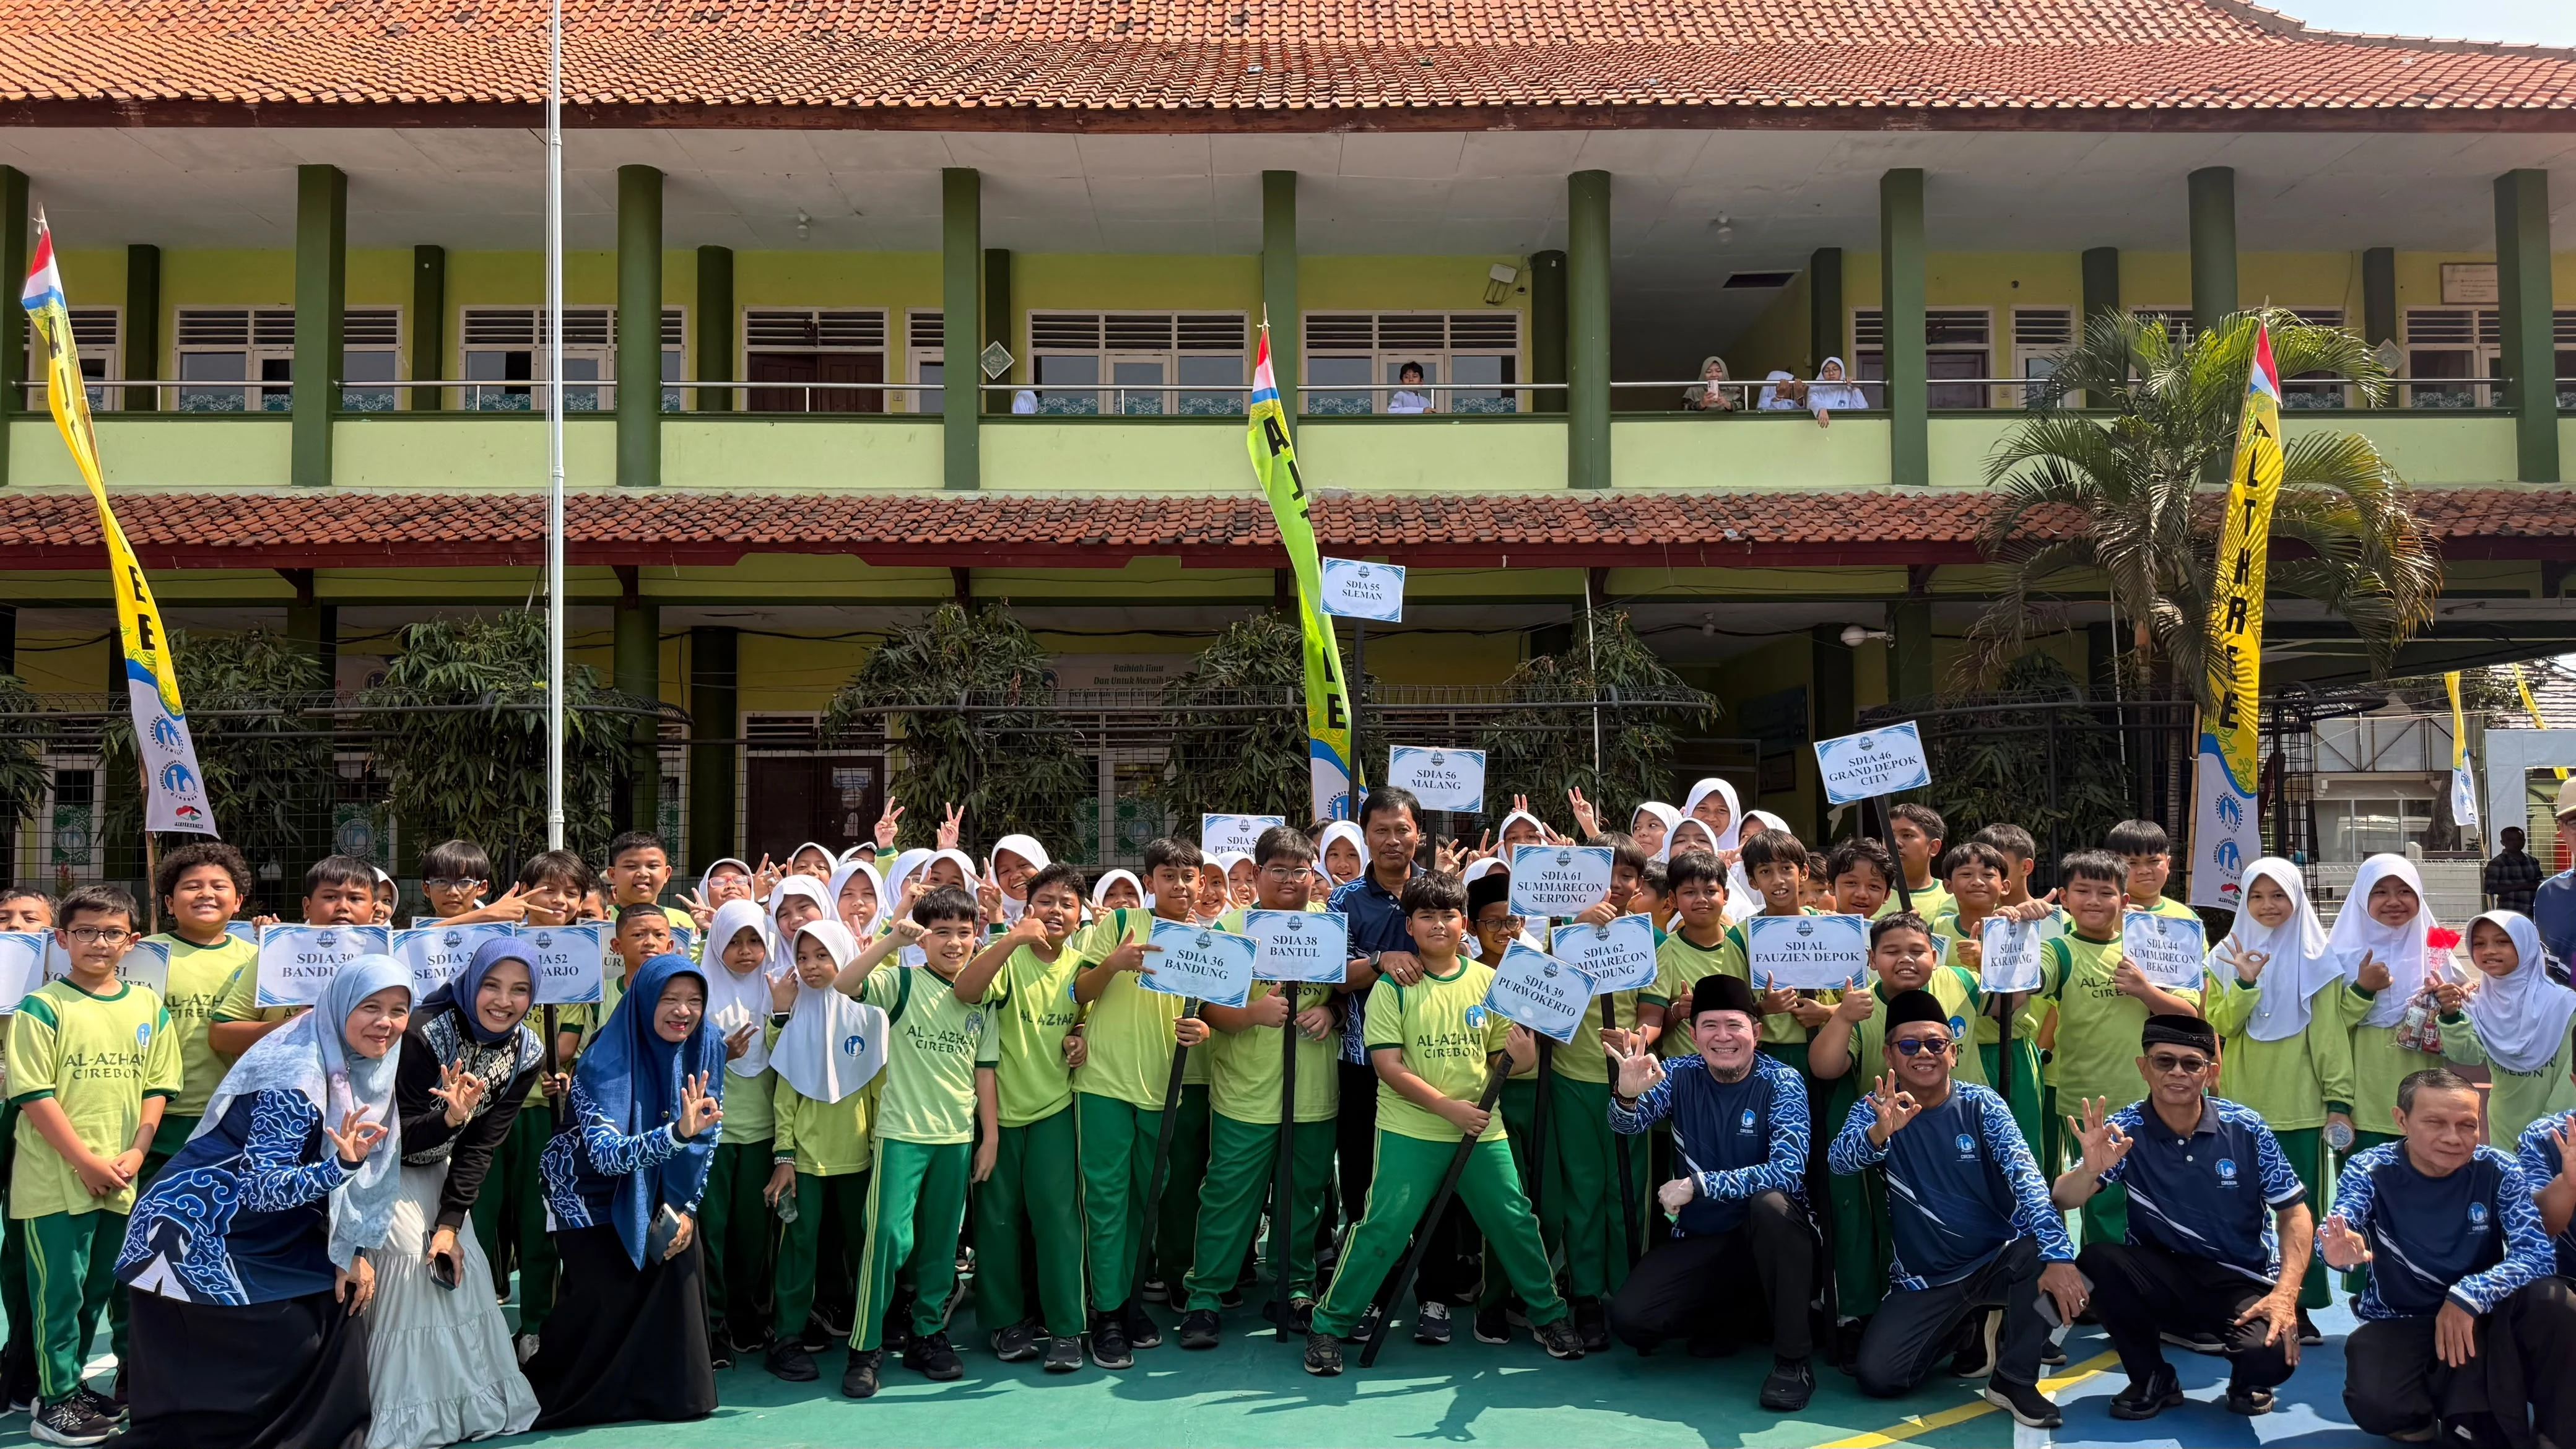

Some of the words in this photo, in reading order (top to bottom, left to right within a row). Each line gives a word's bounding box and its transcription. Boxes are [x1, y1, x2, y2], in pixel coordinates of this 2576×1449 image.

[1346, 580, 1368, 590] SDIA
[1370, 583, 1380, 591] 55
[1342, 589, 1383, 601] SLEMAN
[1848, 754, 1877, 767] SDIA
[1879, 751, 1892, 760] 46
[1416, 769, 1443, 779] SDIA
[1445, 771, 1456, 780] 56
[1829, 765, 1871, 782] GRAND
[1874, 755, 1918, 773] DEPOK
[1411, 779, 1461, 790] MALANG
[1860, 772, 1890, 786] CITY
[1227, 836, 1250, 845] SDIA
[1252, 837, 1258, 845] 5
[1214, 846, 1256, 855] PEKANB
[1541, 871, 1568, 881] SDIA
[1571, 871, 1582, 881] 61
[1517, 881, 1603, 893] SUMMARECON
[1531, 893, 1587, 904] SERPONG
[1272, 934, 1302, 946] SDIA
[1304, 936, 1318, 946] 38
[1785, 941, 1806, 951] SDI
[1809, 941, 1827, 951] AL
[2146, 938, 2166, 950] SDIA
[2167, 941, 2178, 951] 44
[1270, 947, 1320, 958] BANTUL
[1583, 947, 1611, 959] SDIA
[1612, 943, 1625, 954] 62
[2128, 947, 2196, 965] SUMMARECON
[296, 953, 335, 964] SDIA
[427, 952, 464, 967] SDIA
[555, 954, 568, 964] 52
[1177, 949, 1207, 965] SDIA
[1212, 955, 1224, 967] 36
[1570, 951, 1648, 971] MMARECON
[1755, 952, 1811, 963] FAUZIEN
[1814, 952, 1861, 962] DEPOK
[1990, 954, 2032, 967] KARAWANG
[282, 967, 334, 978] BAND
[414, 965, 461, 980] SEMA
[1164, 958, 1229, 981] BANDUNG
[1593, 965, 1635, 981] NDUNG
[2146, 961, 2178, 975] BEKASI
[1523, 974, 1550, 994] SDIA
[1552, 987, 1564, 998] 39
[1497, 977, 1576, 1017] PURWOKERTO
[1424, 1046, 1480, 1059] CIREBON
[72, 1068, 142, 1080] CIREBON
